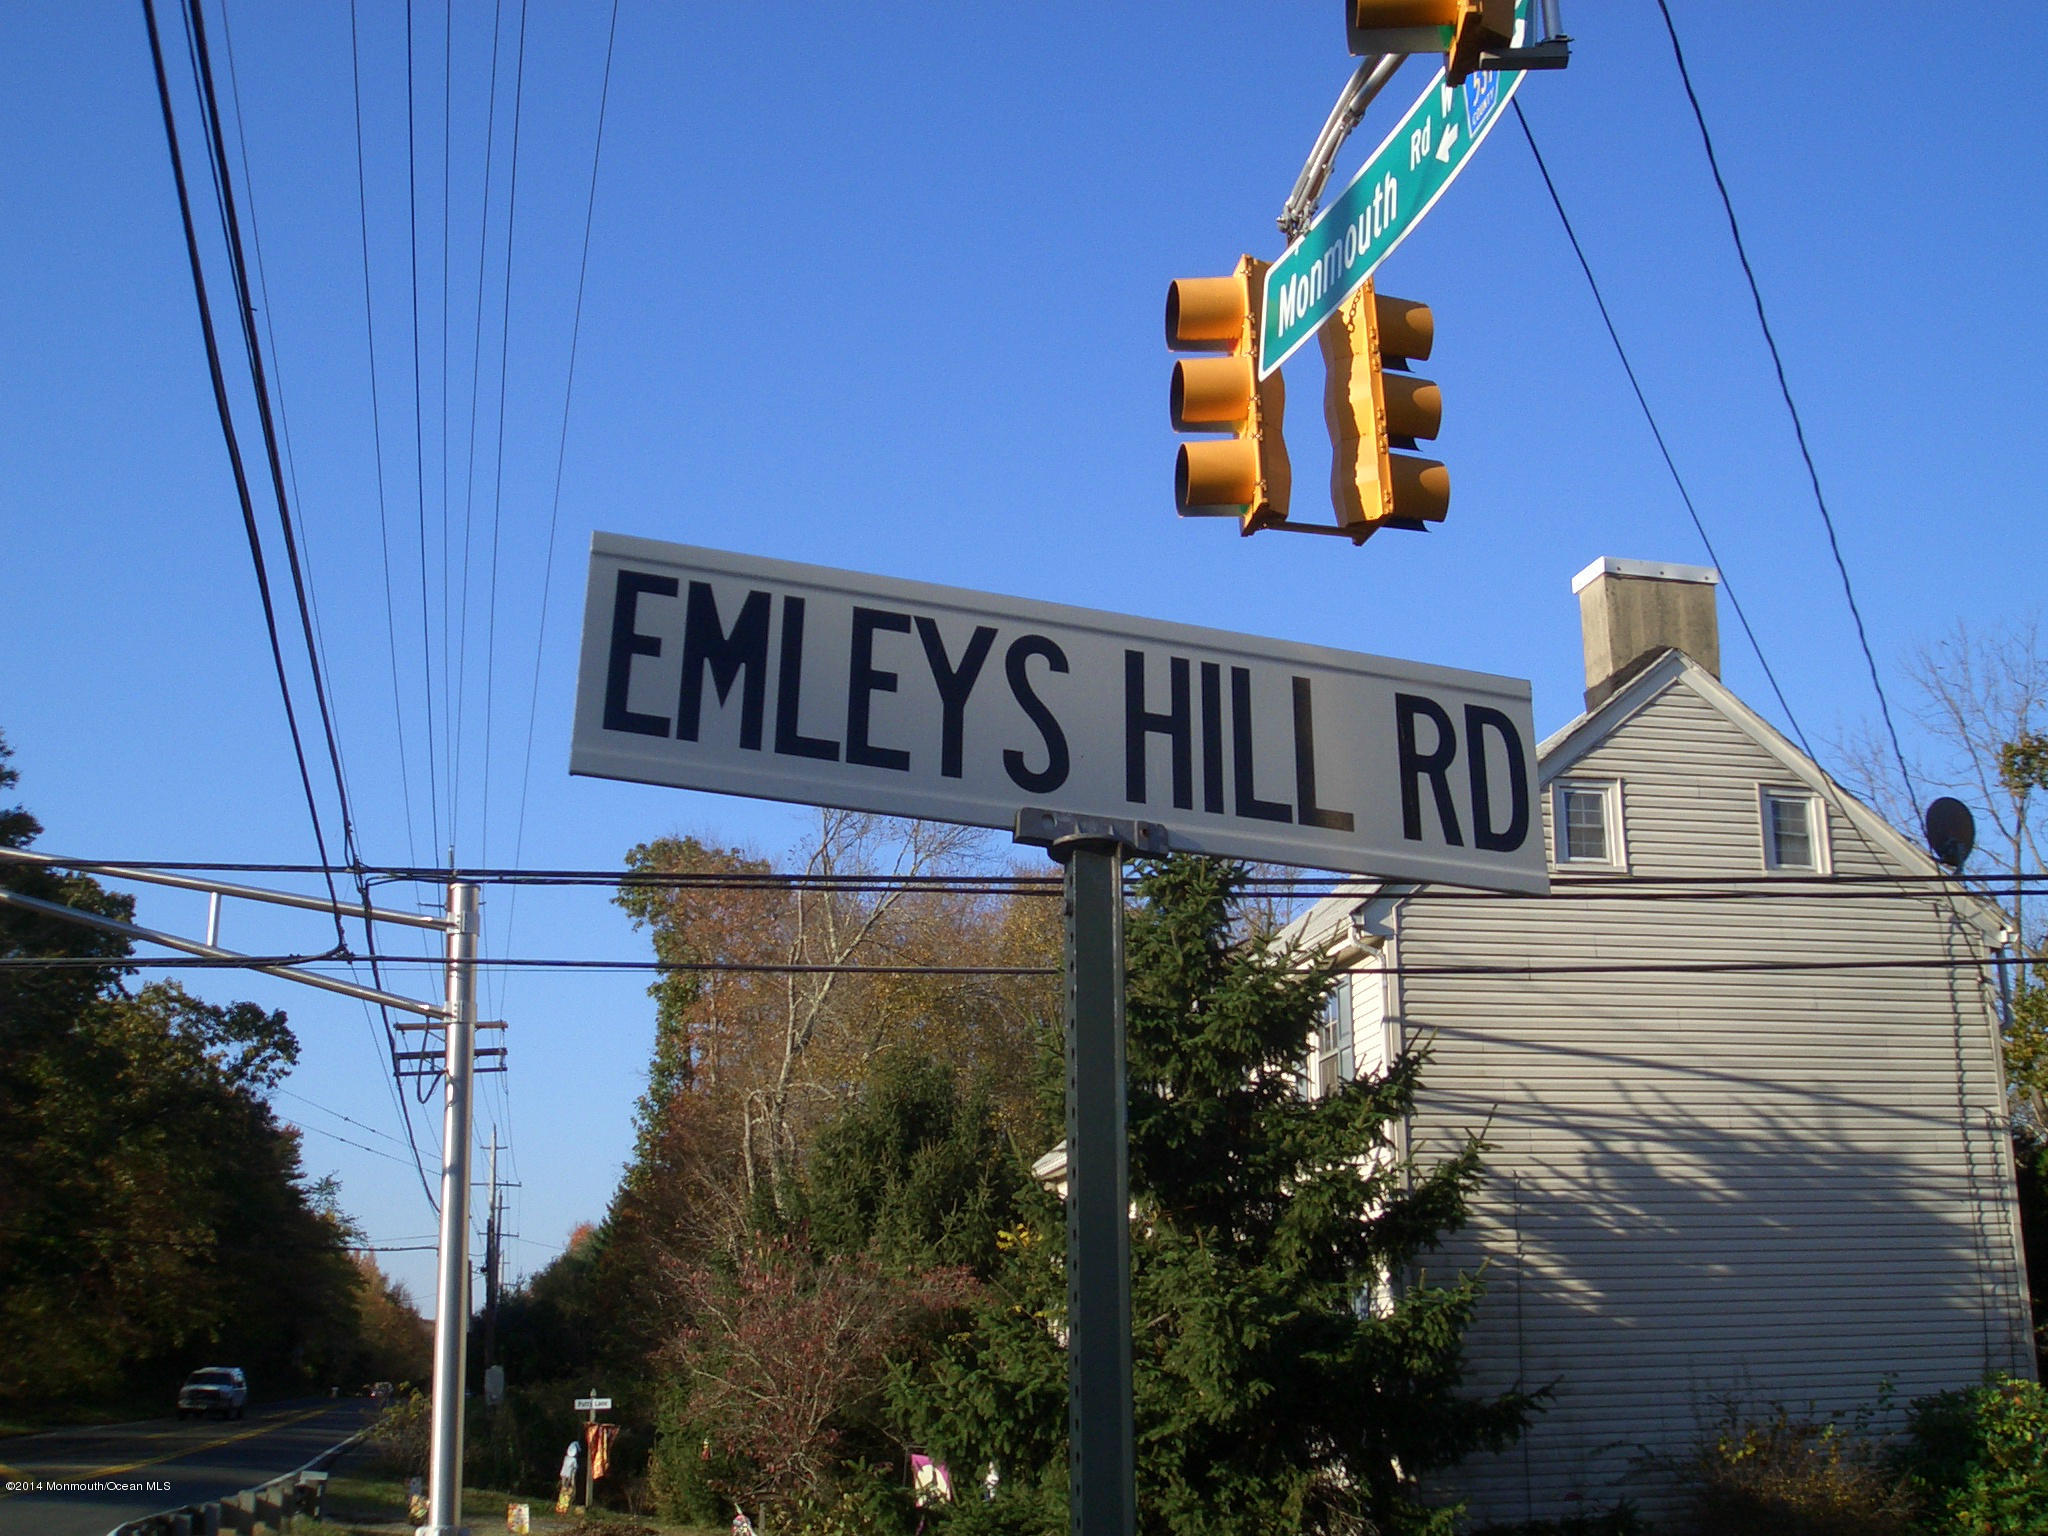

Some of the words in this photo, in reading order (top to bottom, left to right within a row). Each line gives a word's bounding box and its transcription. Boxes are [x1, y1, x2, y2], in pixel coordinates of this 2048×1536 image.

[1277, 170, 1398, 338] Monmouth
[1409, 115, 1431, 171] Rd
[602, 569, 1070, 794] EMLEYS
[1124, 649, 1355, 832] HILL
[1395, 692, 1530, 852] RD
